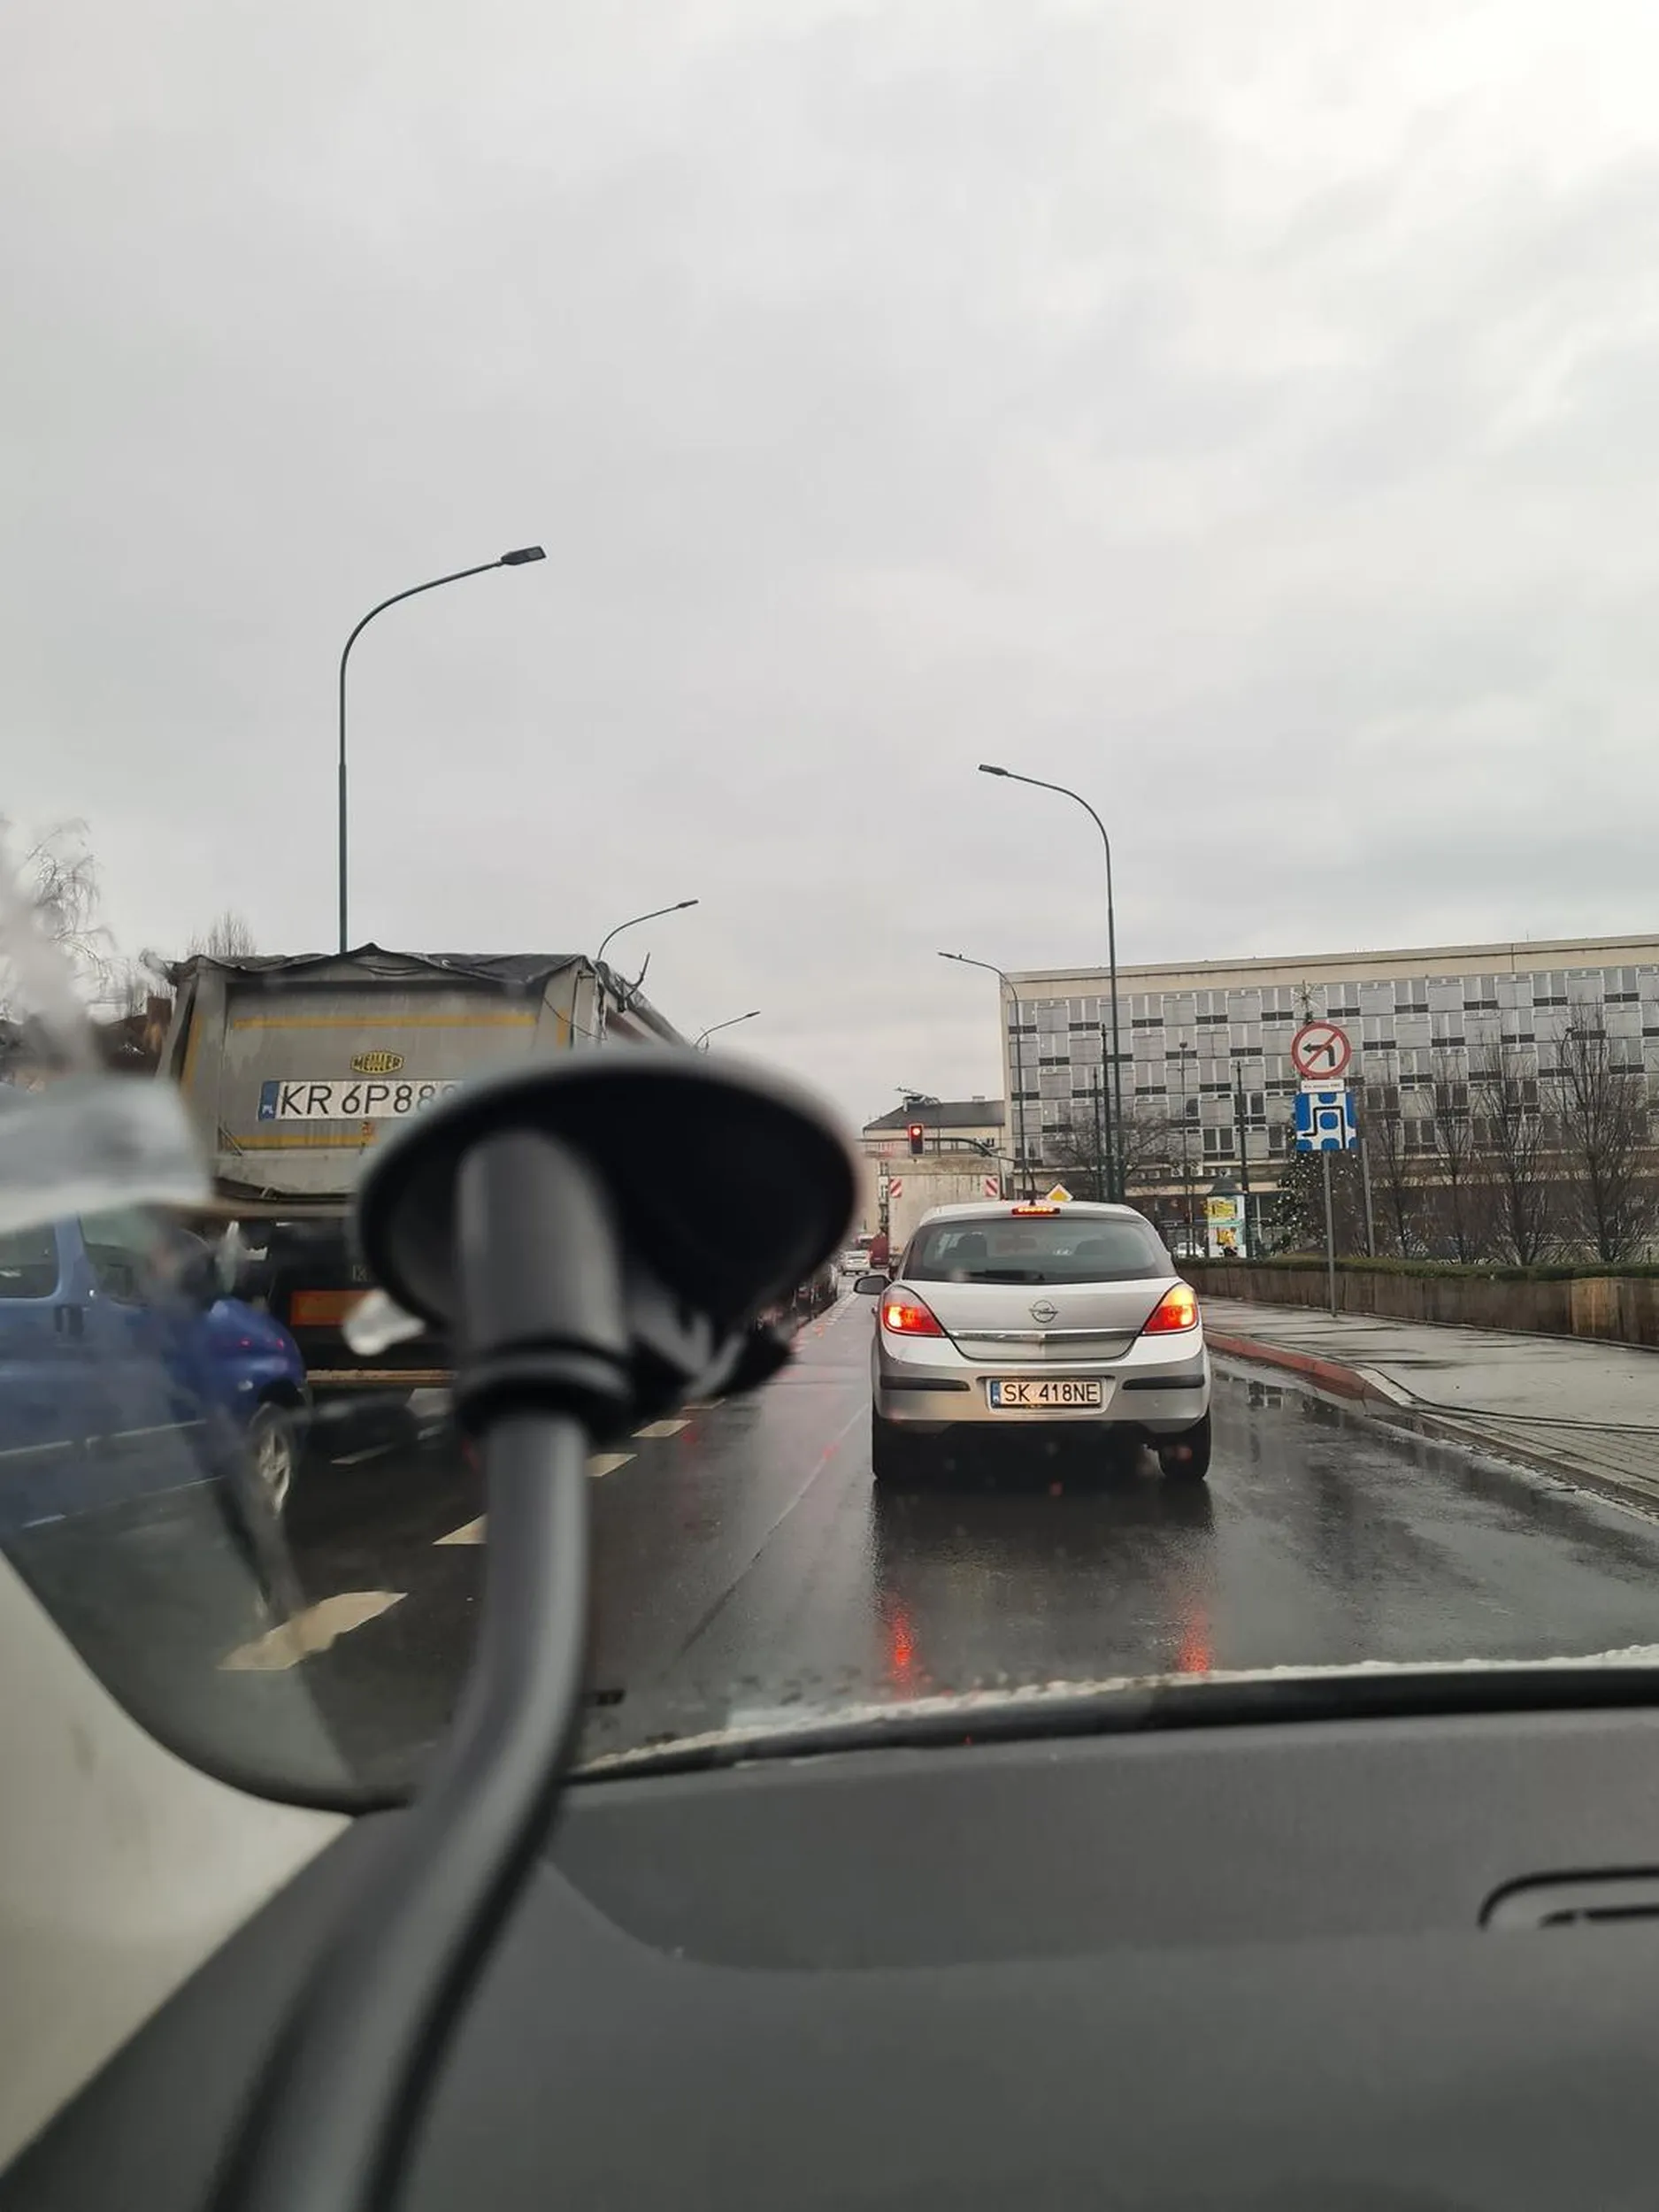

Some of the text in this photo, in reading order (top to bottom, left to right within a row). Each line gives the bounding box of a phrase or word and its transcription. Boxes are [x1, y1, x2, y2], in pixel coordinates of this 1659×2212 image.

[280, 1085, 333, 1115] KR
[1003, 1383, 1098, 1402] SK 418NE
